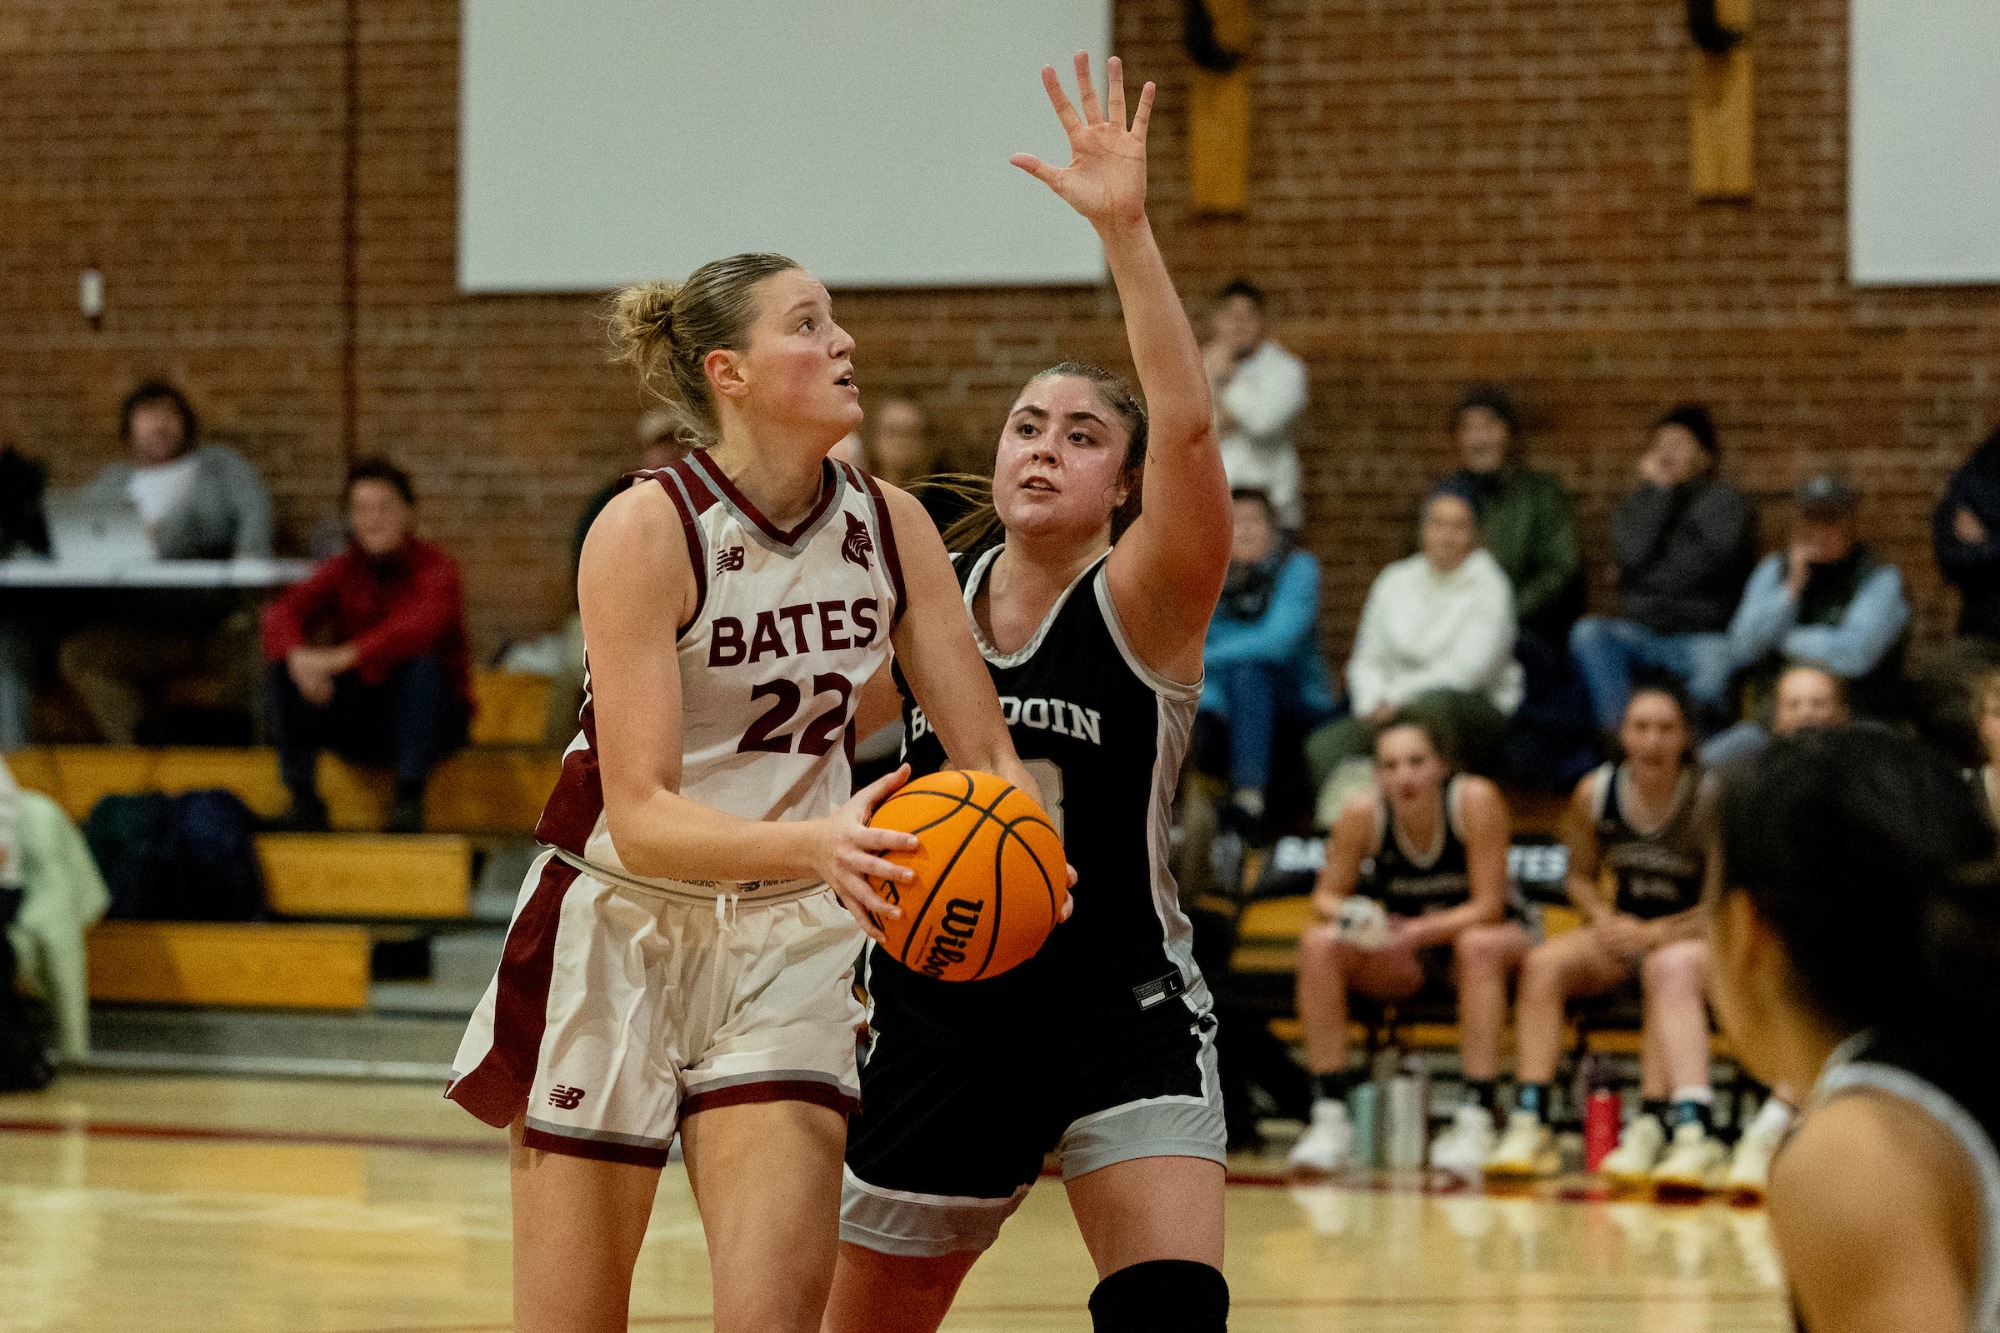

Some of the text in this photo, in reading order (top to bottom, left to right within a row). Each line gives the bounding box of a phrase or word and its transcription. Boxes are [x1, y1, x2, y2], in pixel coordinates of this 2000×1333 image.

[707, 598, 878, 667] BATES
[736, 672, 852, 756] 22
[911, 696, 1101, 745] BDOIN
[921, 898, 984, 977] Wilso
[1169, 980, 1178, 990] L
